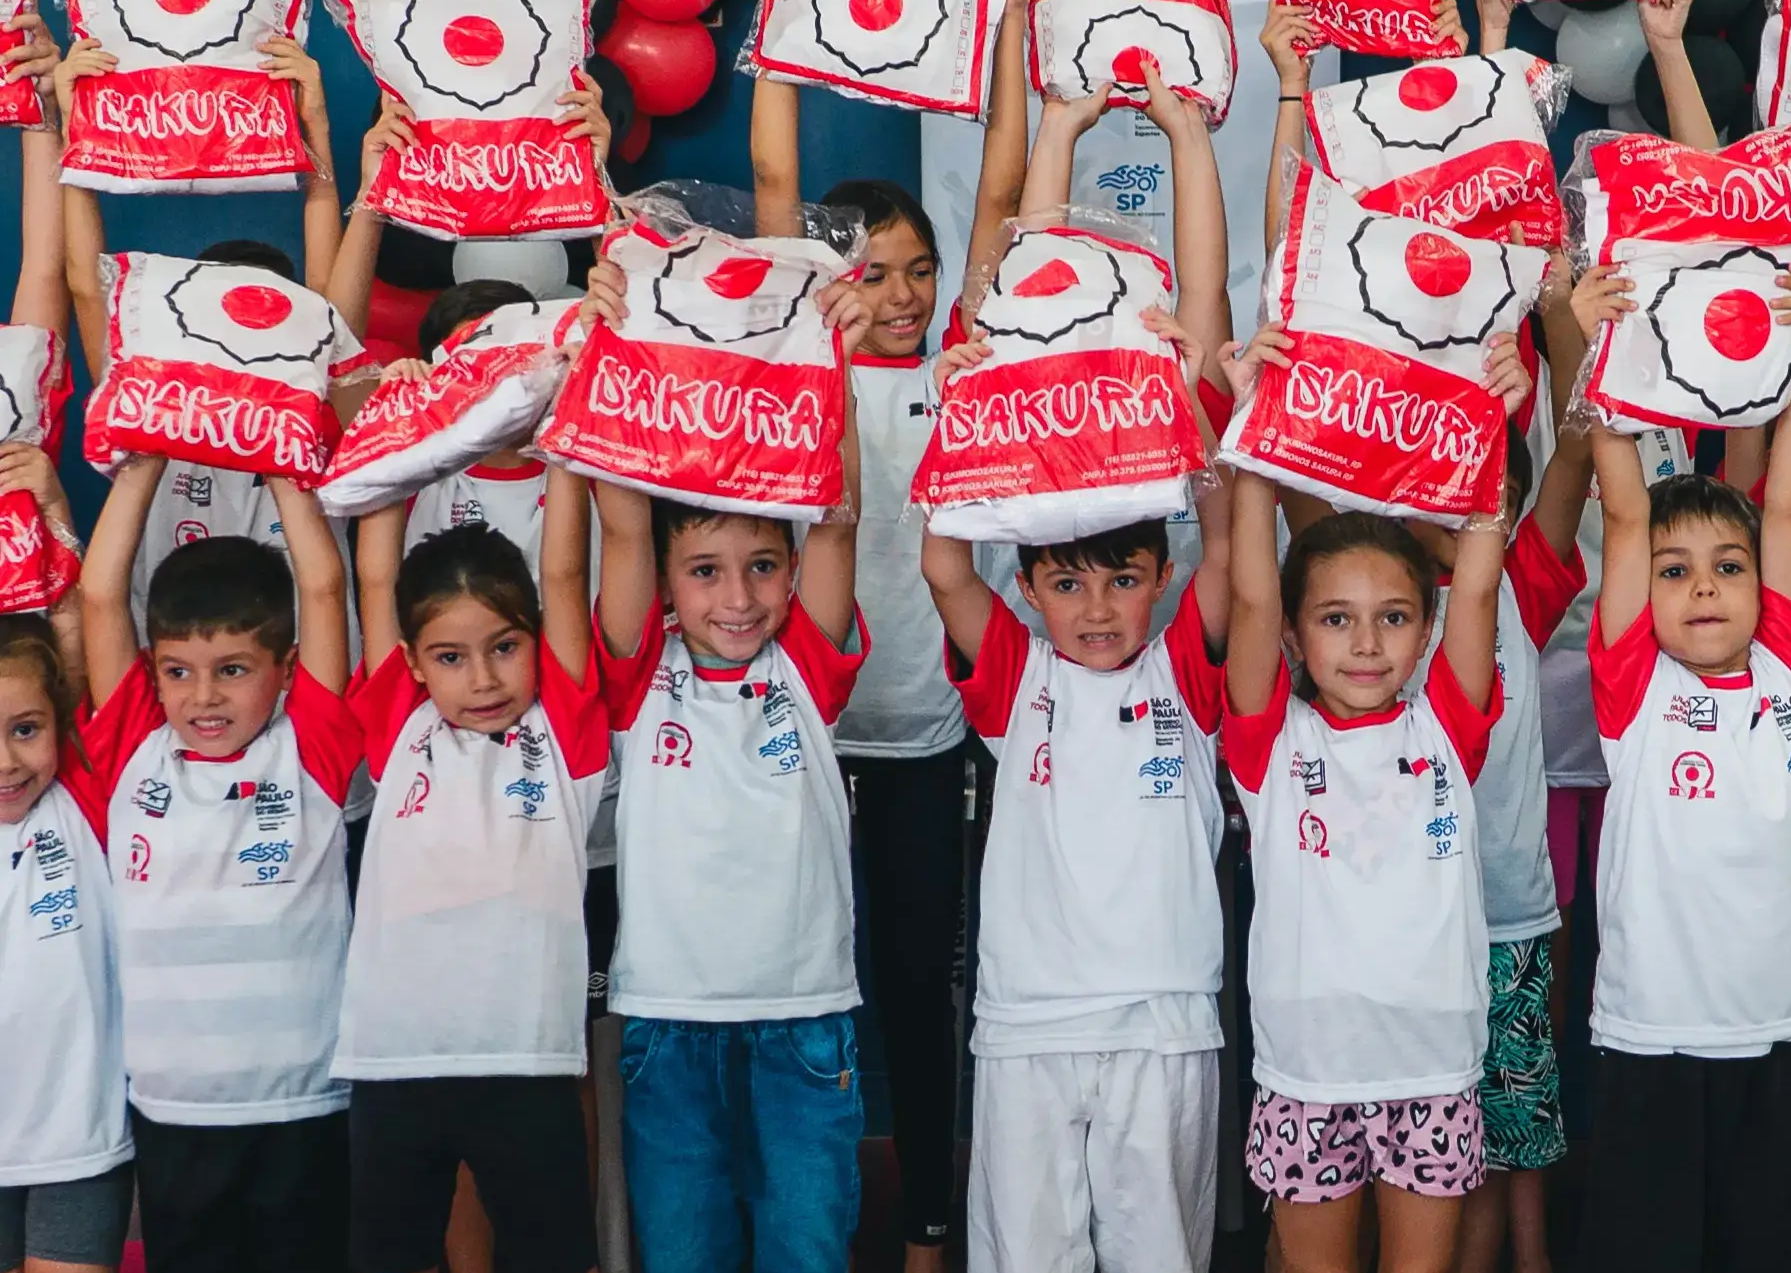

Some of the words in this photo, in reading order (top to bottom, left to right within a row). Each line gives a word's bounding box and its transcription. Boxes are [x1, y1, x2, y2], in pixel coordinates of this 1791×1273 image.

[97, 88, 288, 140] SAKURA
[398, 140, 584, 193] SAKURA
[1116, 193, 1146, 211] SP
[588, 355, 823, 452] SAKURA
[939, 373, 1174, 453] SAKURA
[1310, 460, 1343, 479] SAKURA
[1342, 472, 1355, 482] RP
[1150, 697, 1172, 708] SÃO
[1663, 713, 1688, 724] TODOS
[779, 754, 801, 771] SP
[1153, 780, 1174, 794] SP
[35, 838, 64, 853] PAUL
[1436, 840, 1452, 856] SP
[257, 866, 280, 881] SP
[51, 914, 73, 931] SP
